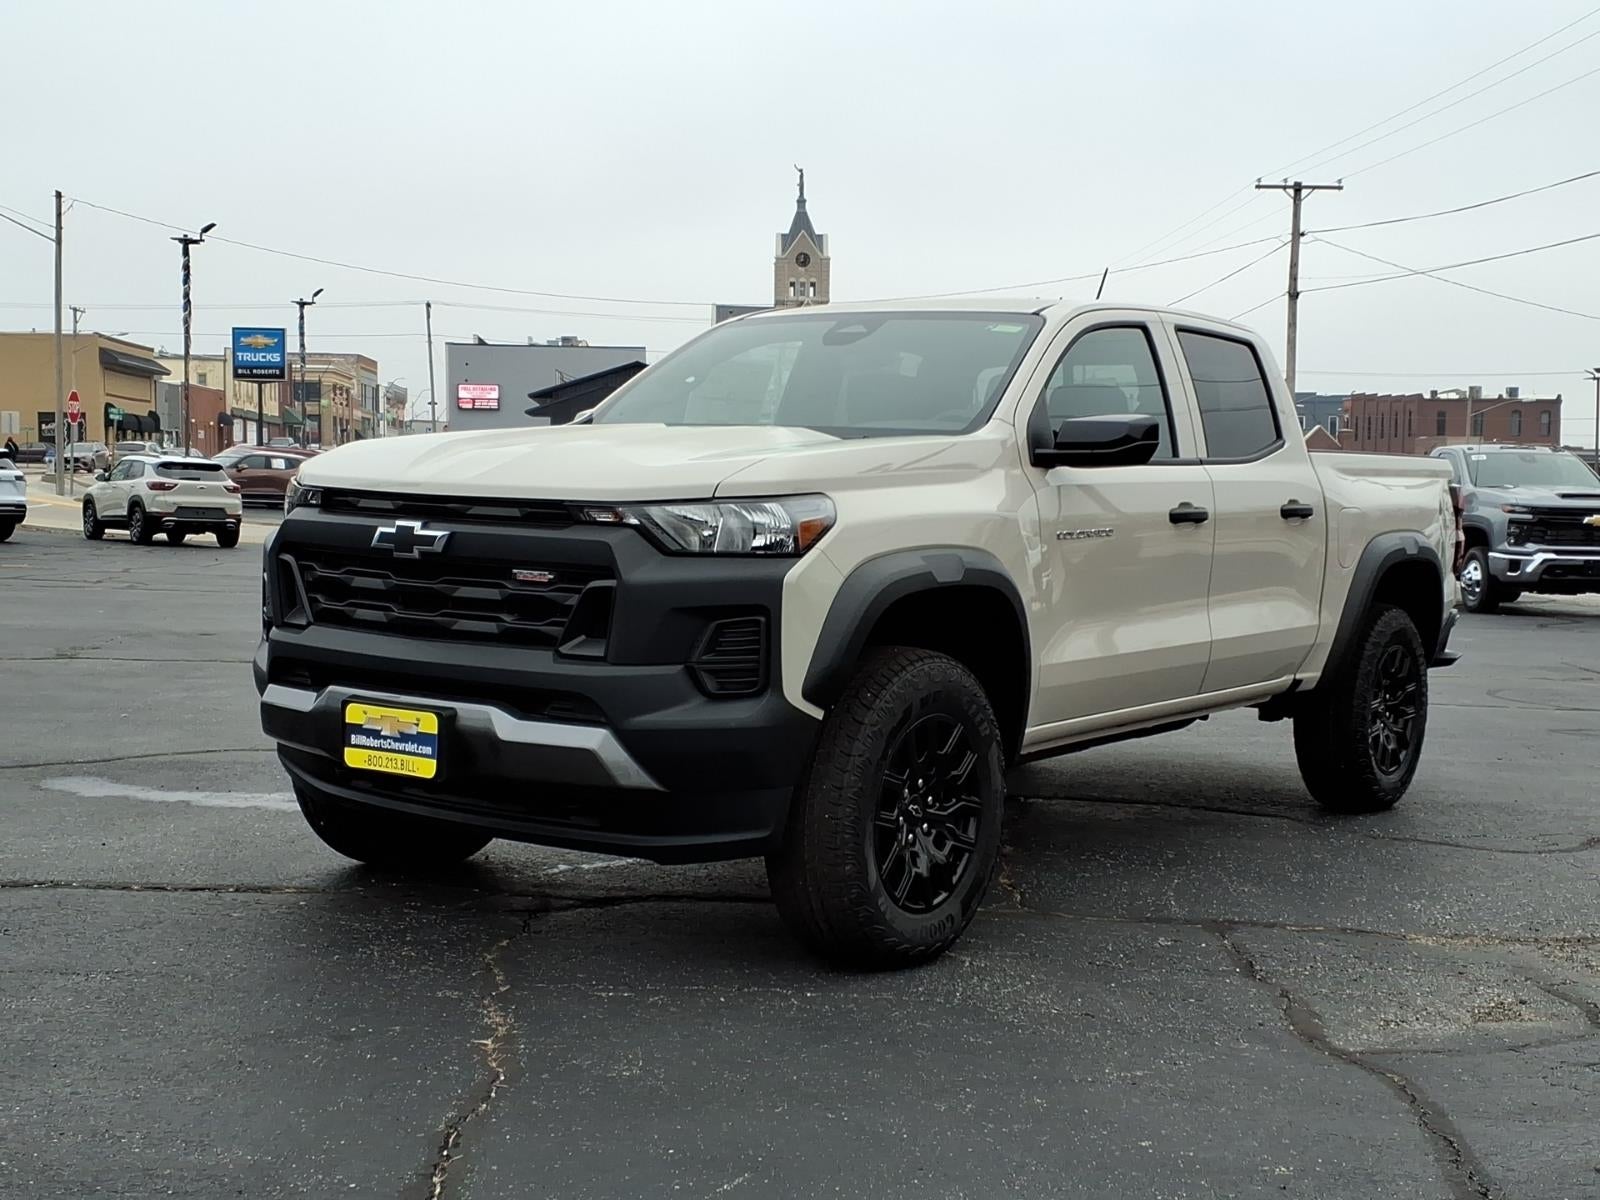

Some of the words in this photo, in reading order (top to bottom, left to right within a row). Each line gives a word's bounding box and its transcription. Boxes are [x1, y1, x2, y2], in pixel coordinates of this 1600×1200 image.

[236, 352, 281, 362] TRUCKS
[68, 401, 80, 414] STOP
[350, 734, 433, 756] BillRobertsChevrolet.com
